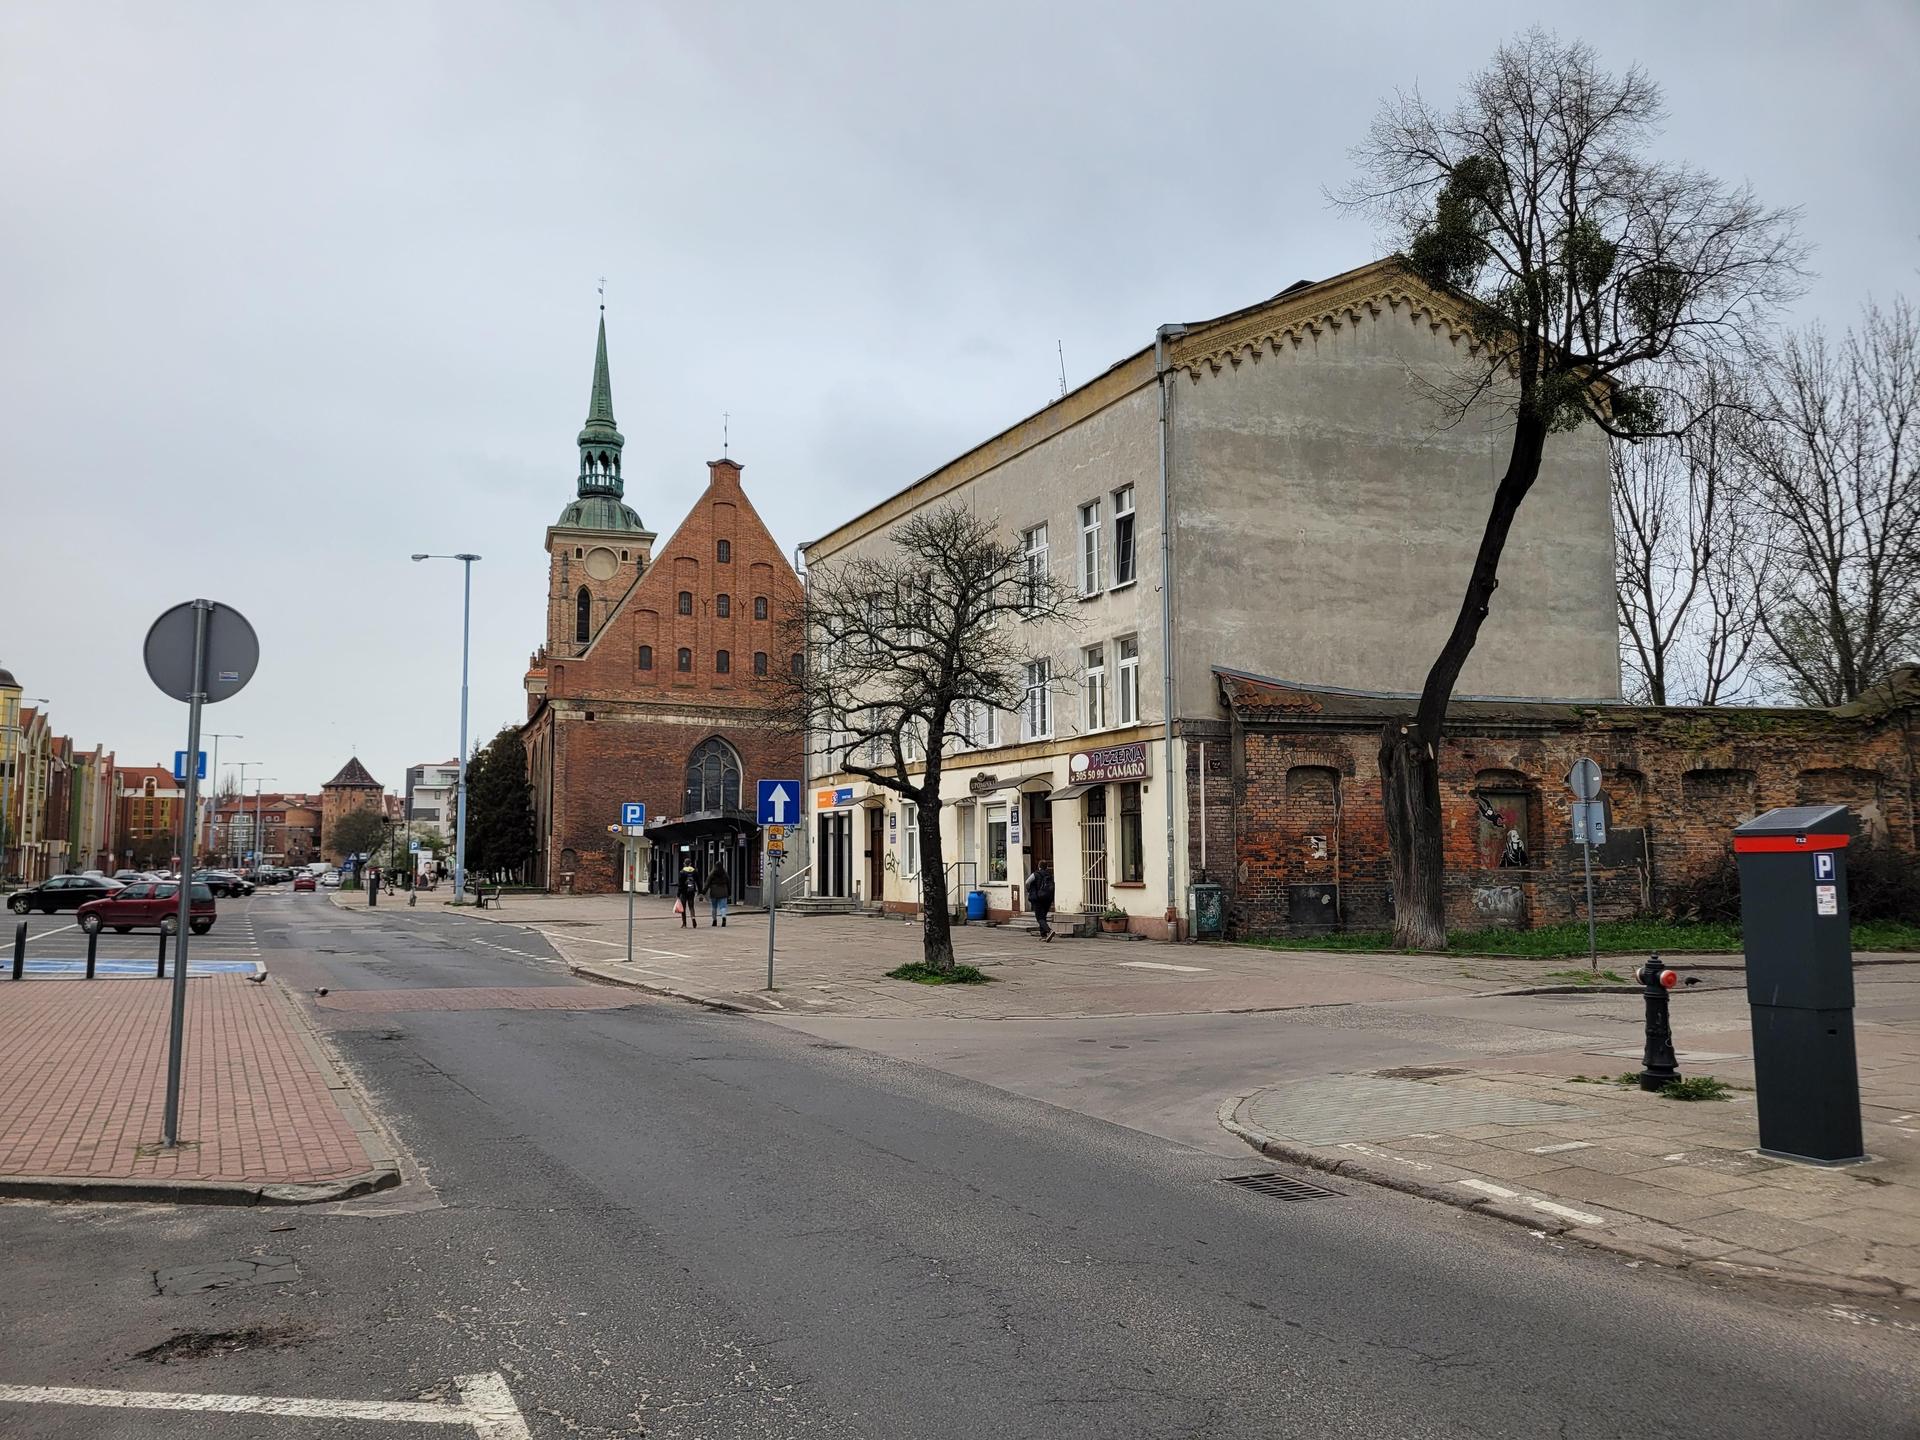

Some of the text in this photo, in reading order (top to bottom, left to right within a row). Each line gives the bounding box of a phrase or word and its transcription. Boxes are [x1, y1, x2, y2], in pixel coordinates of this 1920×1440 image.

[1092, 746, 1145, 767] PIZZERIA
[1076, 769, 1105, 781] 305 50 99
[1107, 762, 1145, 778] CAMARO
[627, 806, 640, 823] P
[411, 842, 418, 850] P
[1817, 855, 1831, 878] P
